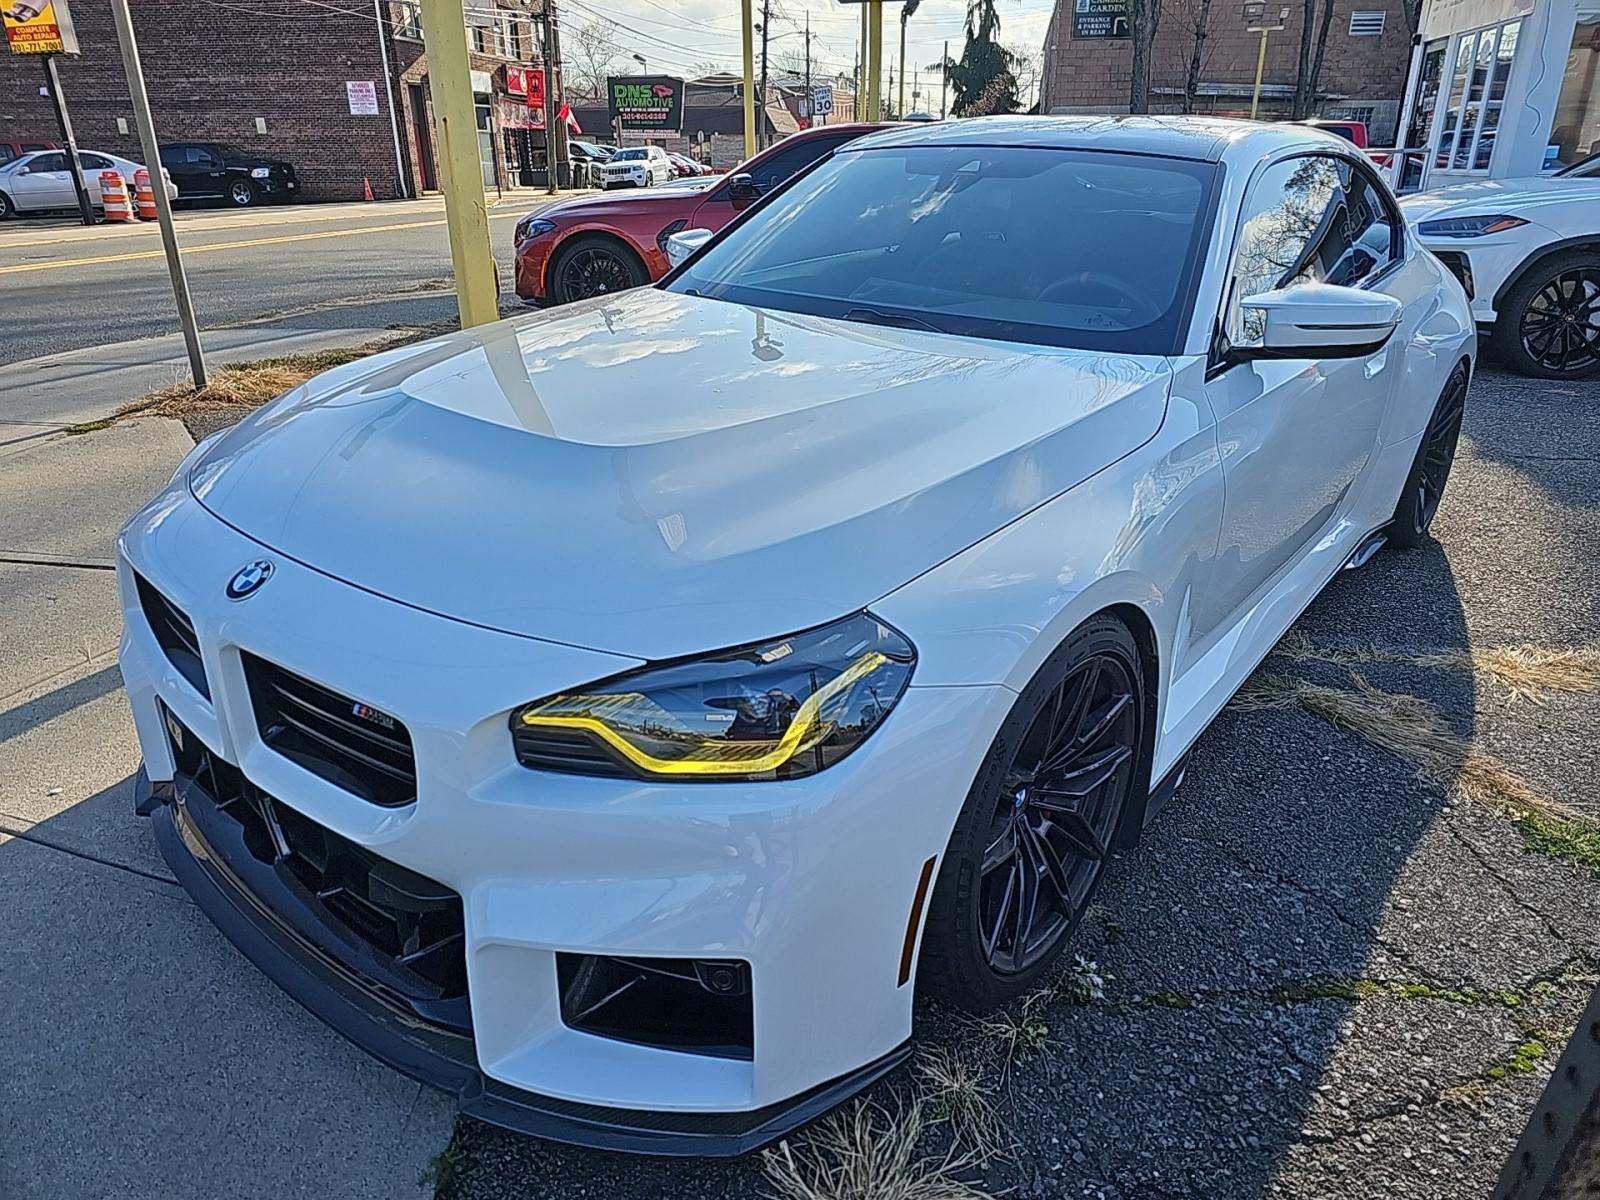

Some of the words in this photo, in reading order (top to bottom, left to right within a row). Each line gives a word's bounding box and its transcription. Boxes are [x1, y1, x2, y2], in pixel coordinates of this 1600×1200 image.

[15, 25, 51, 33] COMPLETE
[614, 84, 652, 98] DNS
[616, 97, 673, 108] AUTOMOTIVE
[816, 100, 831, 111] 30
